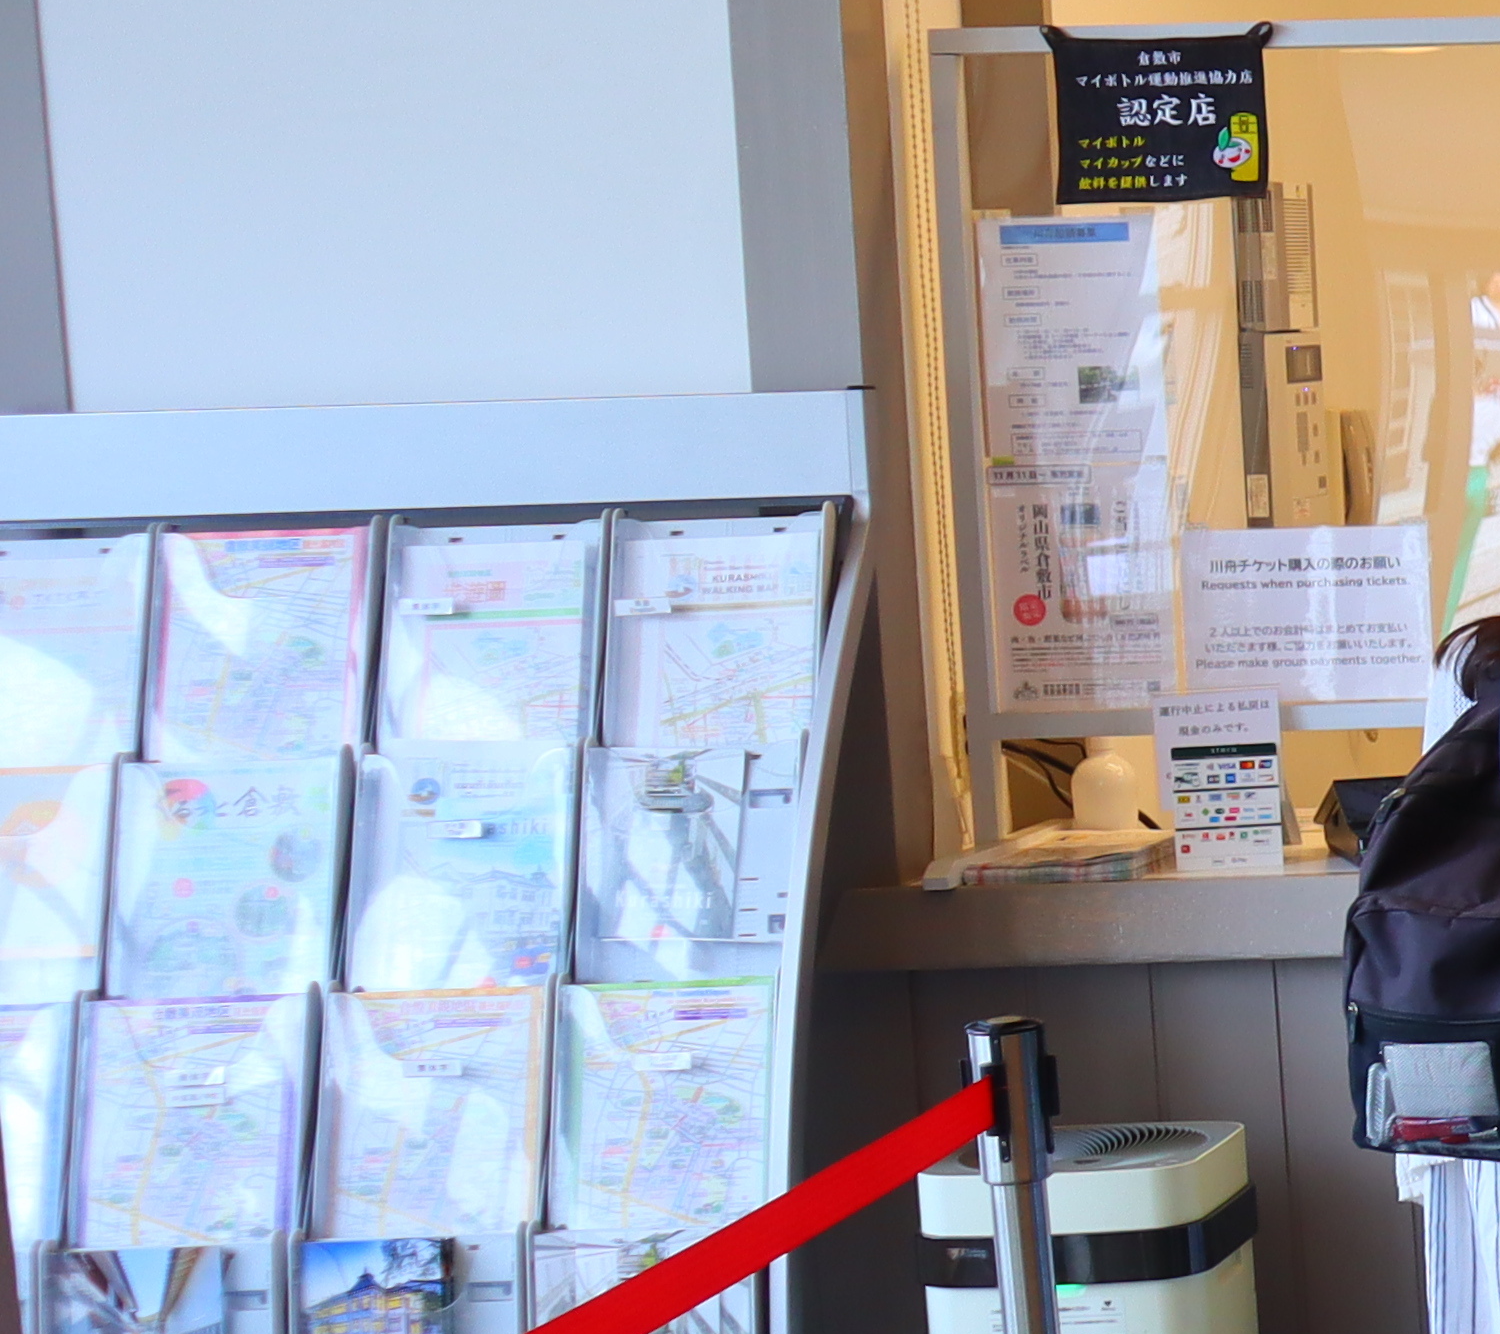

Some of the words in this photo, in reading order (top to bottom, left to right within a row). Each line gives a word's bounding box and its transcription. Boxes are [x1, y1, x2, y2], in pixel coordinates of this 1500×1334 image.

[1137, 50, 1181, 66] 倉敷市
[1116, 93, 1217, 127] 認定店
[1078, 135, 1146, 149] マイボトル
[1079, 154, 1185, 169] マイカップなどに
[1032, 504, 1052, 600] 岡山県倉敷市
[1201, 580, 1257, 591] Requests
[1260, 578, 1293, 589] when
